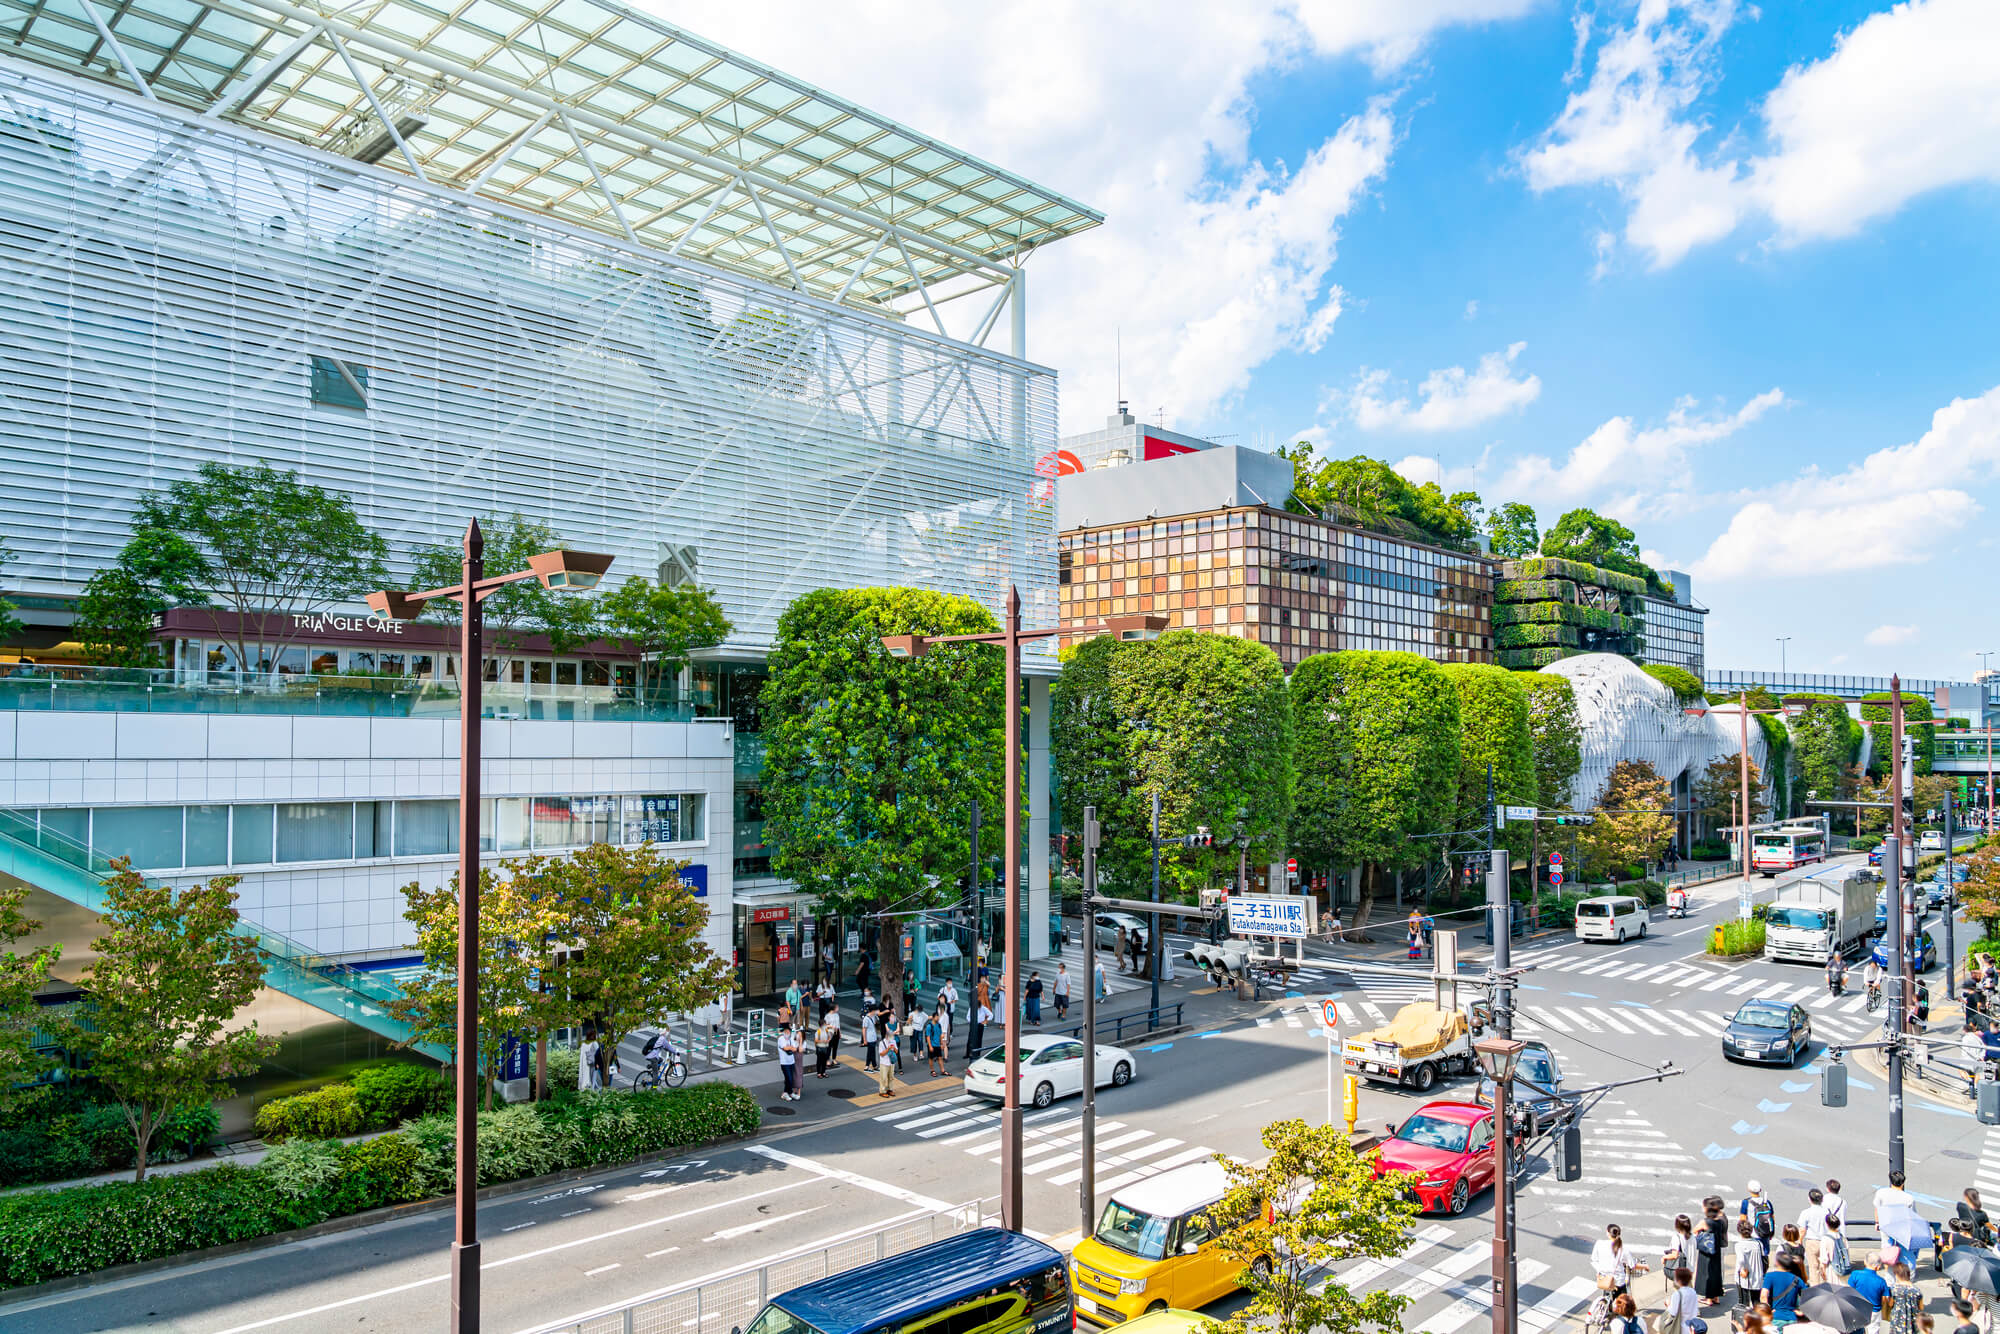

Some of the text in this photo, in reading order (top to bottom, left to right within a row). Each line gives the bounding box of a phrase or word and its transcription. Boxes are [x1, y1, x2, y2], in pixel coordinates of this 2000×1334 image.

[292, 611, 403, 634] TRIANGLE CAFE
[1231, 903, 1302, 920] 二子玉川駅
[1232, 917, 1304, 934] Futakotamagawa Sta.
[1038, 1312, 1067, 1330] SYMUNITY
